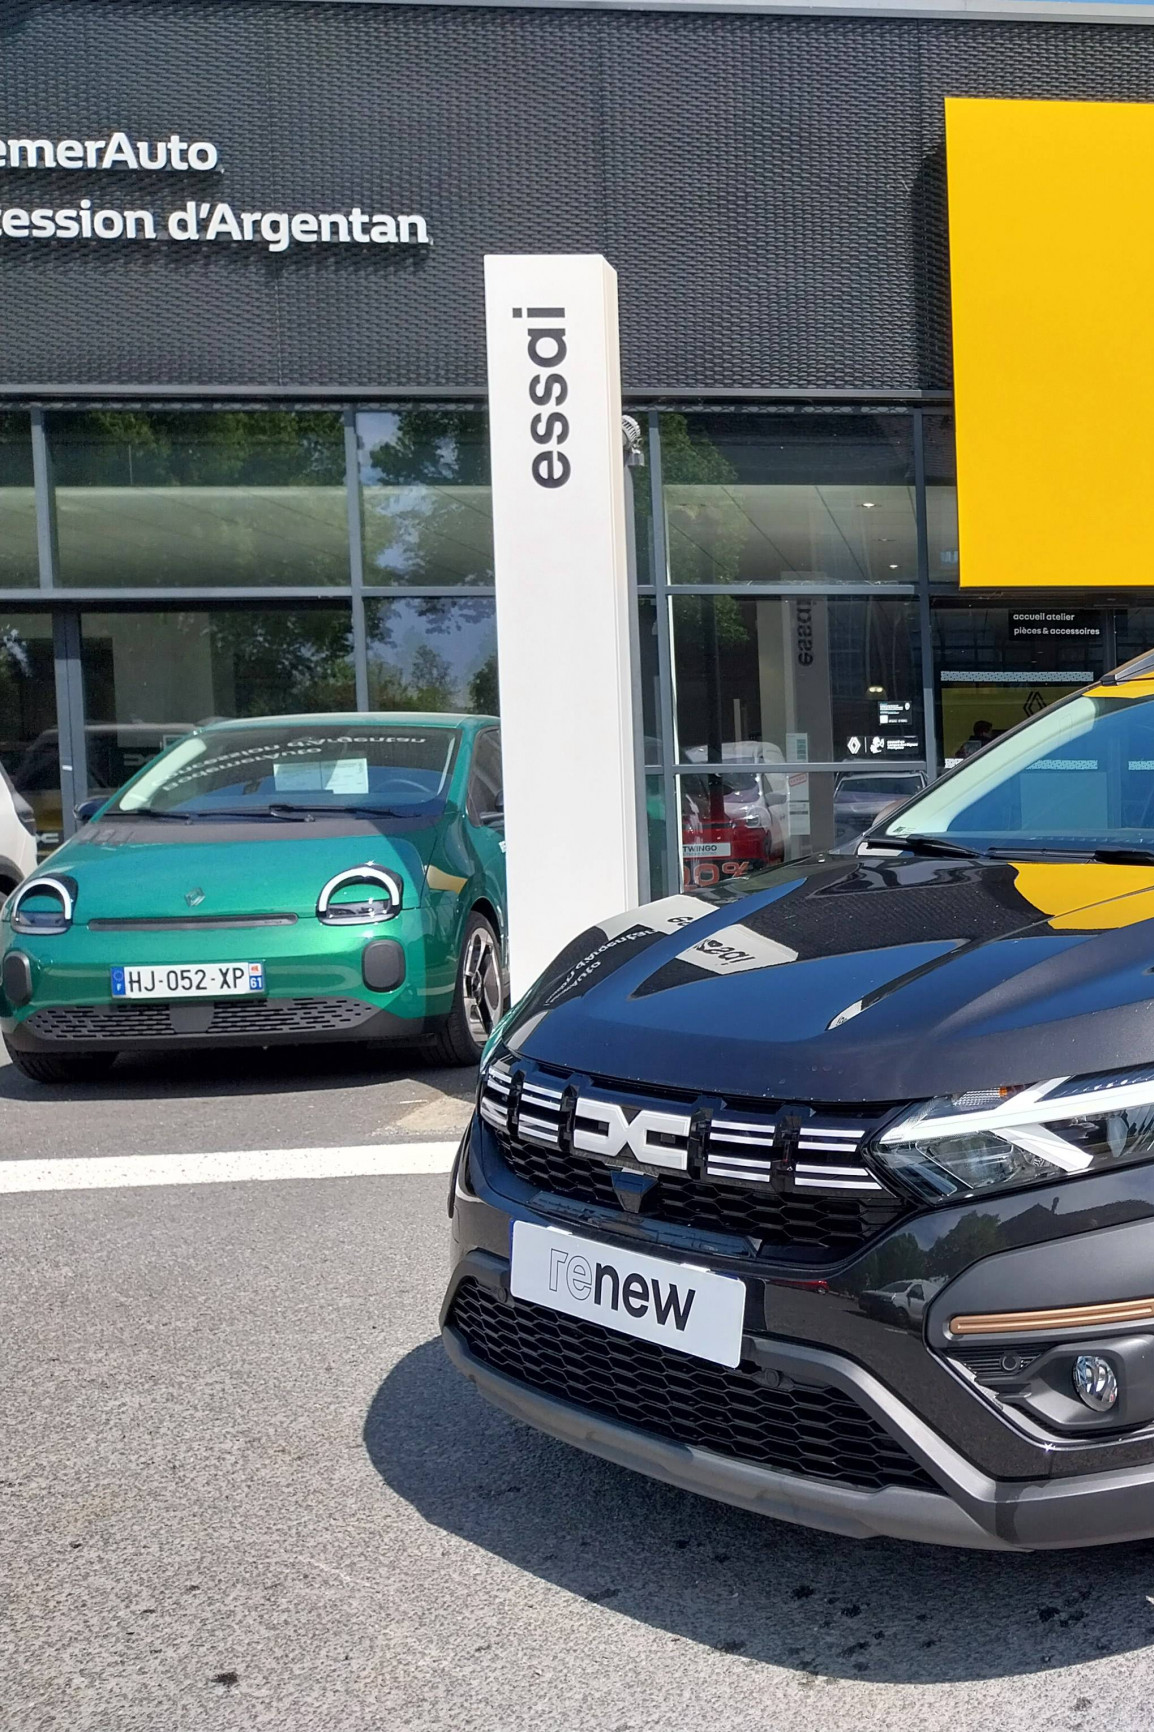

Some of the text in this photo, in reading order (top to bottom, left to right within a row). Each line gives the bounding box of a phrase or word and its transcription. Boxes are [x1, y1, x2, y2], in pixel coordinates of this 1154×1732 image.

[0, 132, 218, 170] merAuto
[0, 199, 429, 252] ession d'Argentan
[512, 307, 571, 489] essai
[1013, 612, 1075, 620] accueil atelier
[1014, 626, 1100, 636] pièces & accessoires
[683, 844, 718, 853] TWINGO
[128, 967, 245, 993] HJ-052-XP
[250, 976, 263, 989] 61
[549, 1248, 696, 1332] renew
